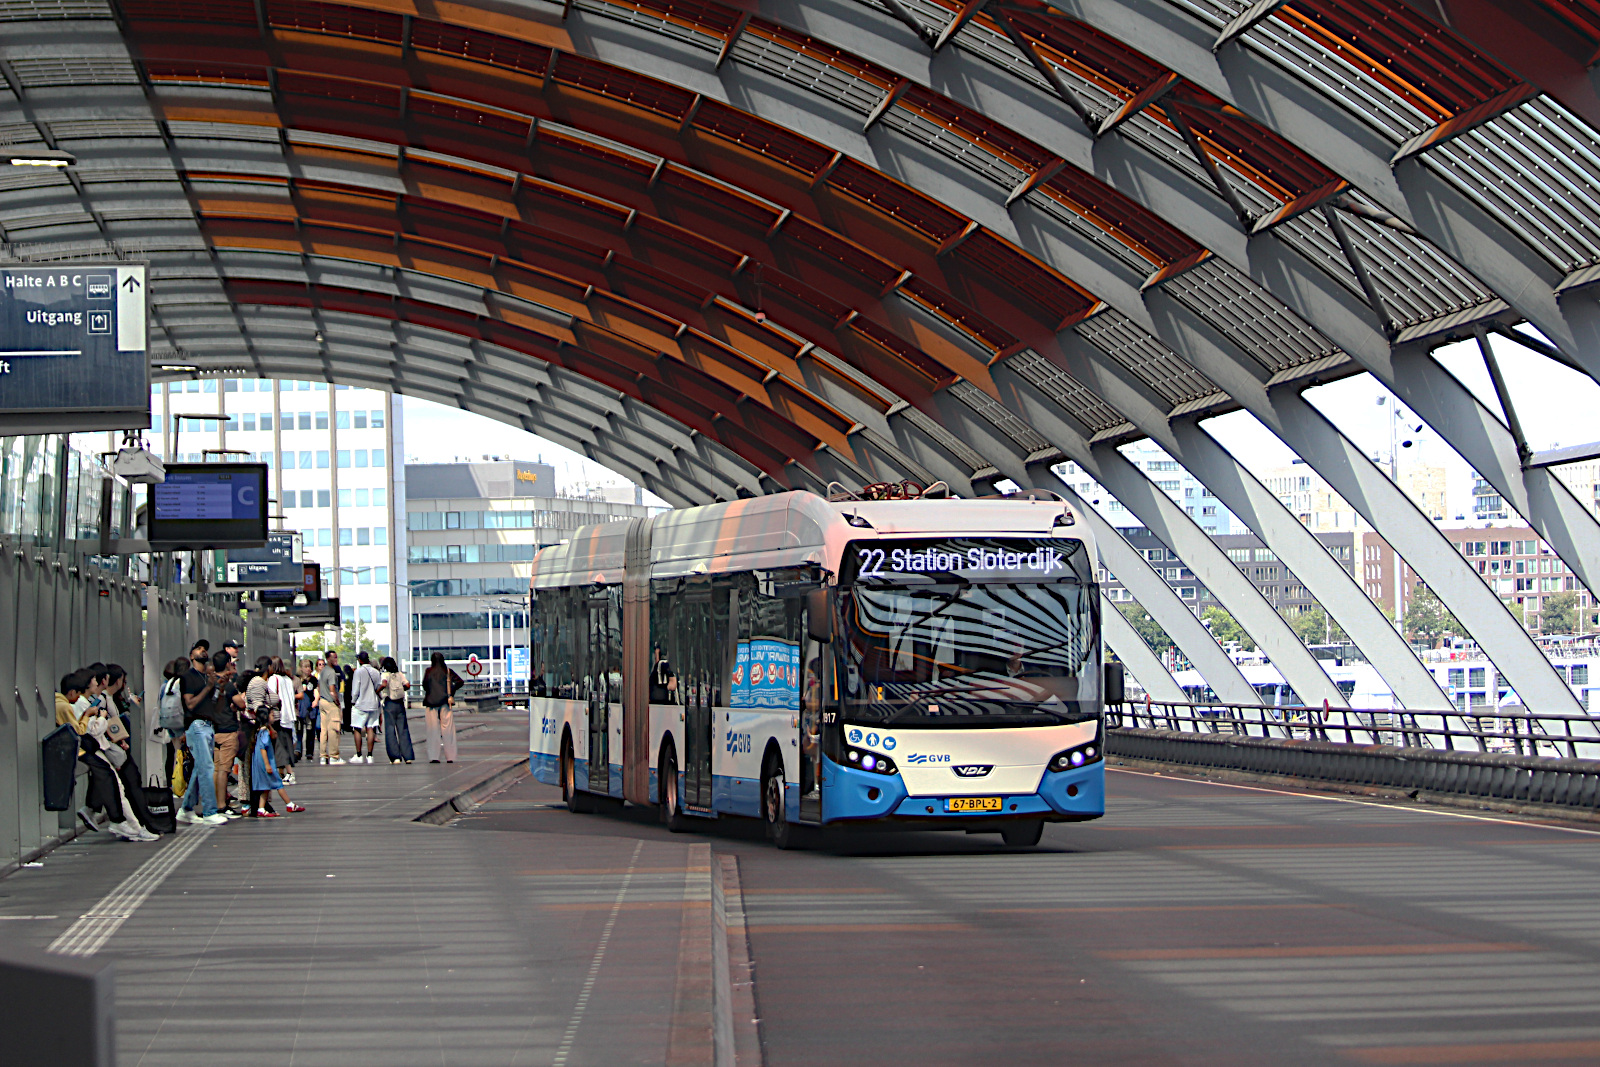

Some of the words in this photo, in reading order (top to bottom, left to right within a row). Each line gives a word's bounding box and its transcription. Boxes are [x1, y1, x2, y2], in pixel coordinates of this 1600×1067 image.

[5, 274, 42, 288] Halte
[46, 275, 56, 287] A
[60, 275, 68, 286] B
[72, 274, 81, 286] C
[26, 309, 82, 326] Uitgang
[237, 486, 254, 505] C
[859, 548, 885, 577] 22
[891, 548, 962, 571] Station
[967, 547, 1063, 575] Sloterdijk
[305, 574, 314, 585] B
[738, 733, 751, 753] GVB
[928, 754, 951, 763] GVB
[958, 766, 987, 775] VDL
[953, 798, 997, 809] 67-BPL-2
